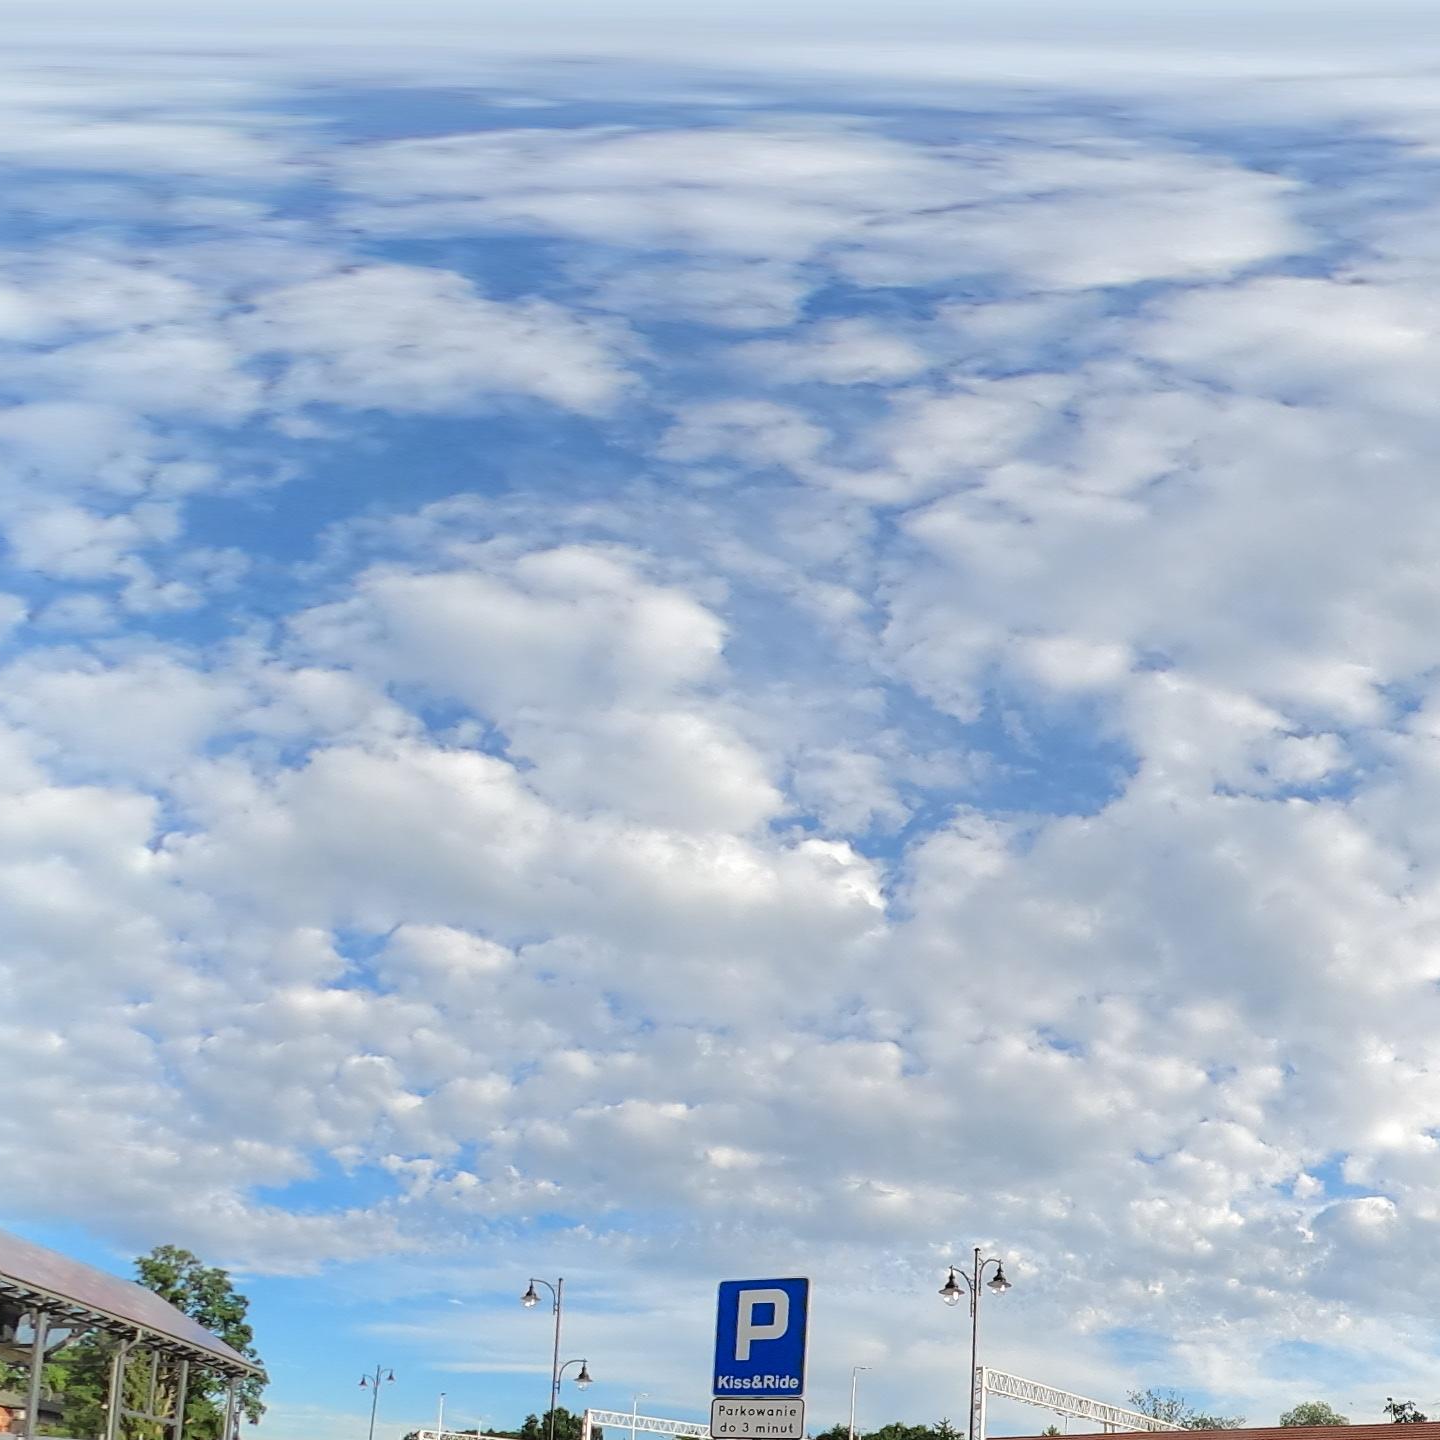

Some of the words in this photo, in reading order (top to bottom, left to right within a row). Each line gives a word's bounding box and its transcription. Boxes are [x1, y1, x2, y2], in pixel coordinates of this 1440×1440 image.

[735, 1288, 790, 1361] P
[717, 1374, 799, 1390] Kiss&Ride
[718, 1405, 797, 1417] Parkowanie
[719, 1423, 736, 1433] do
[742, 1422, 750, 1433] 3
[755, 1422, 794, 1434] minut
